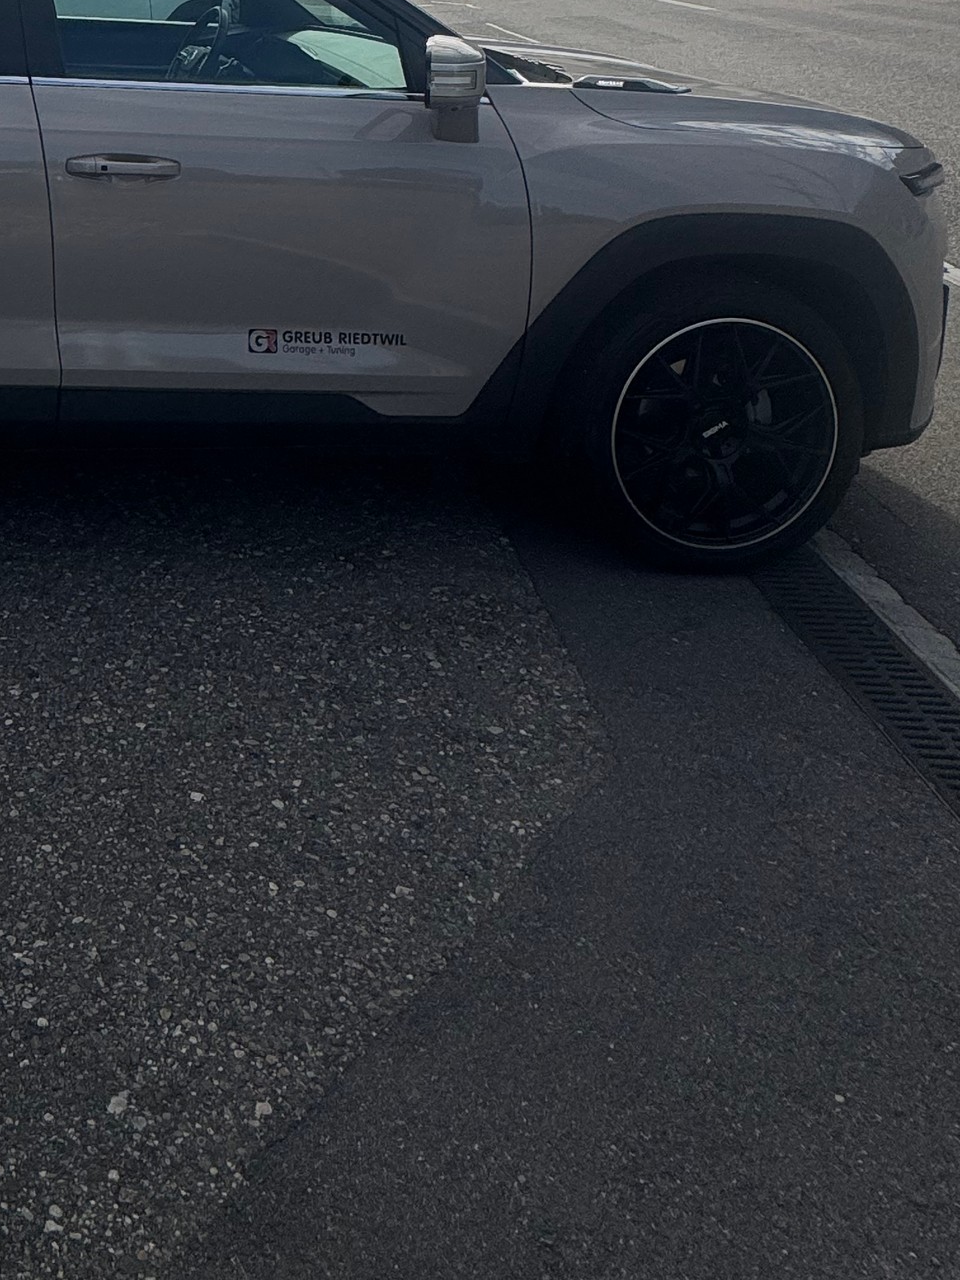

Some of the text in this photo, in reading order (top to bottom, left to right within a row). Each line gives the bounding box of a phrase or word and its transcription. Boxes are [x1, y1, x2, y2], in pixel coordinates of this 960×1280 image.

[282, 331, 407, 346] GREUB RIEDTWIL
[282, 344, 315, 356] Garage
[327, 345, 356, 356] Tuning
